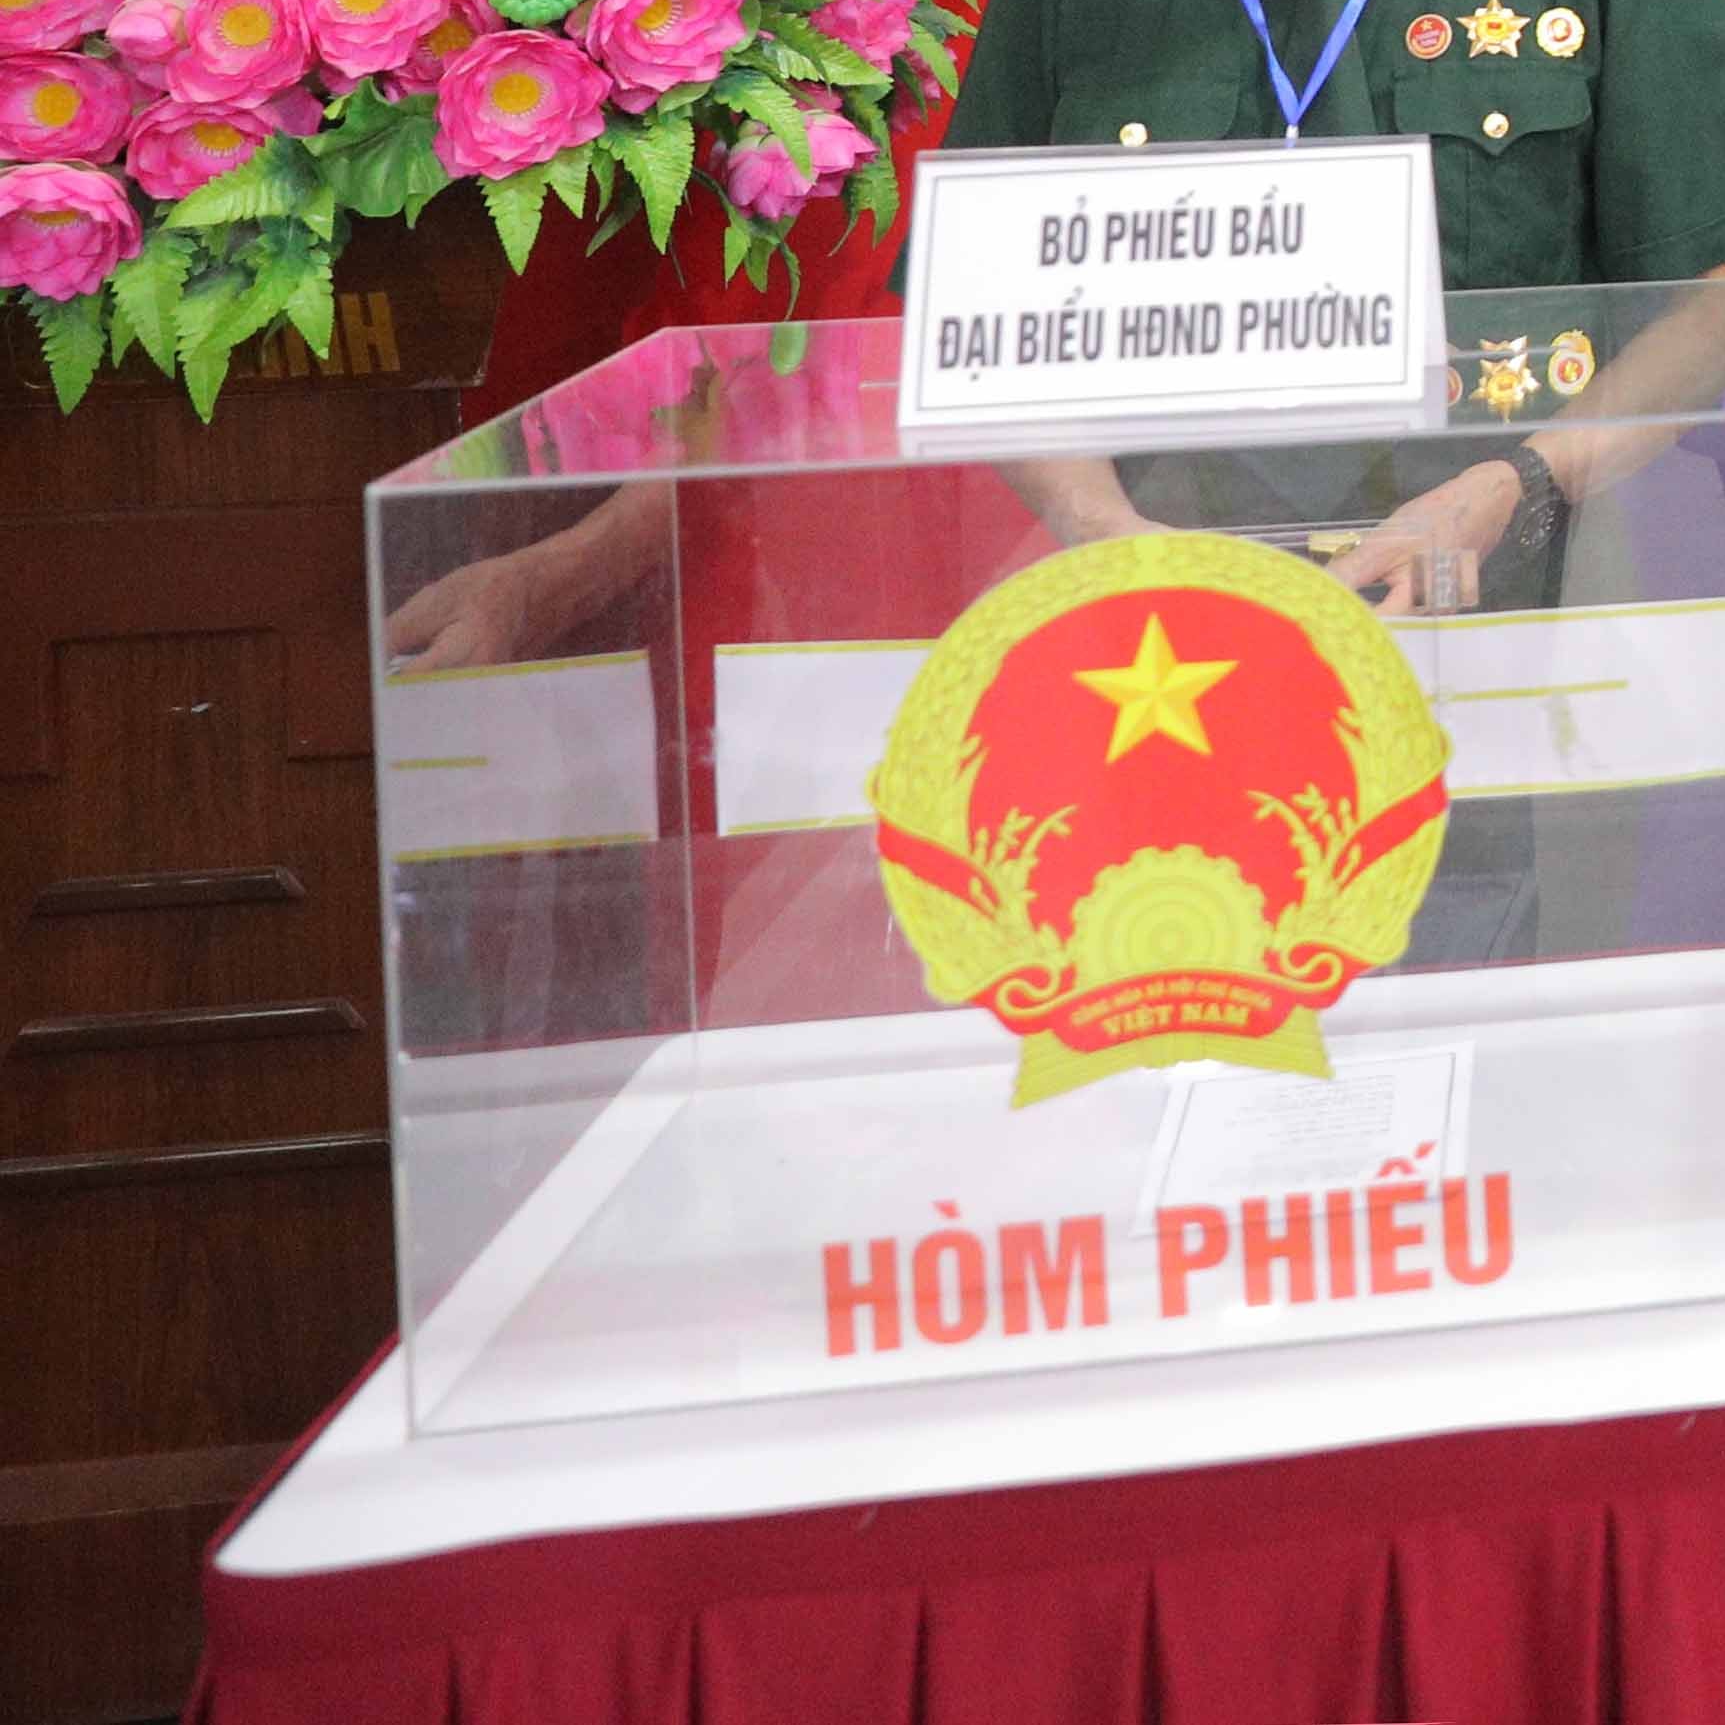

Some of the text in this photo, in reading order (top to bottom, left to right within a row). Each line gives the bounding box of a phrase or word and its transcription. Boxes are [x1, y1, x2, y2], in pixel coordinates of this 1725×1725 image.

[1039, 196, 1088, 266] BỎ
[1103, 191, 1215, 263] PHIẾU
[938, 283, 1393, 380] ĐẠI BIỂU HĐND PHƯỜNG
[822, 1141, 1514, 1358] HÒM PHIẾU
